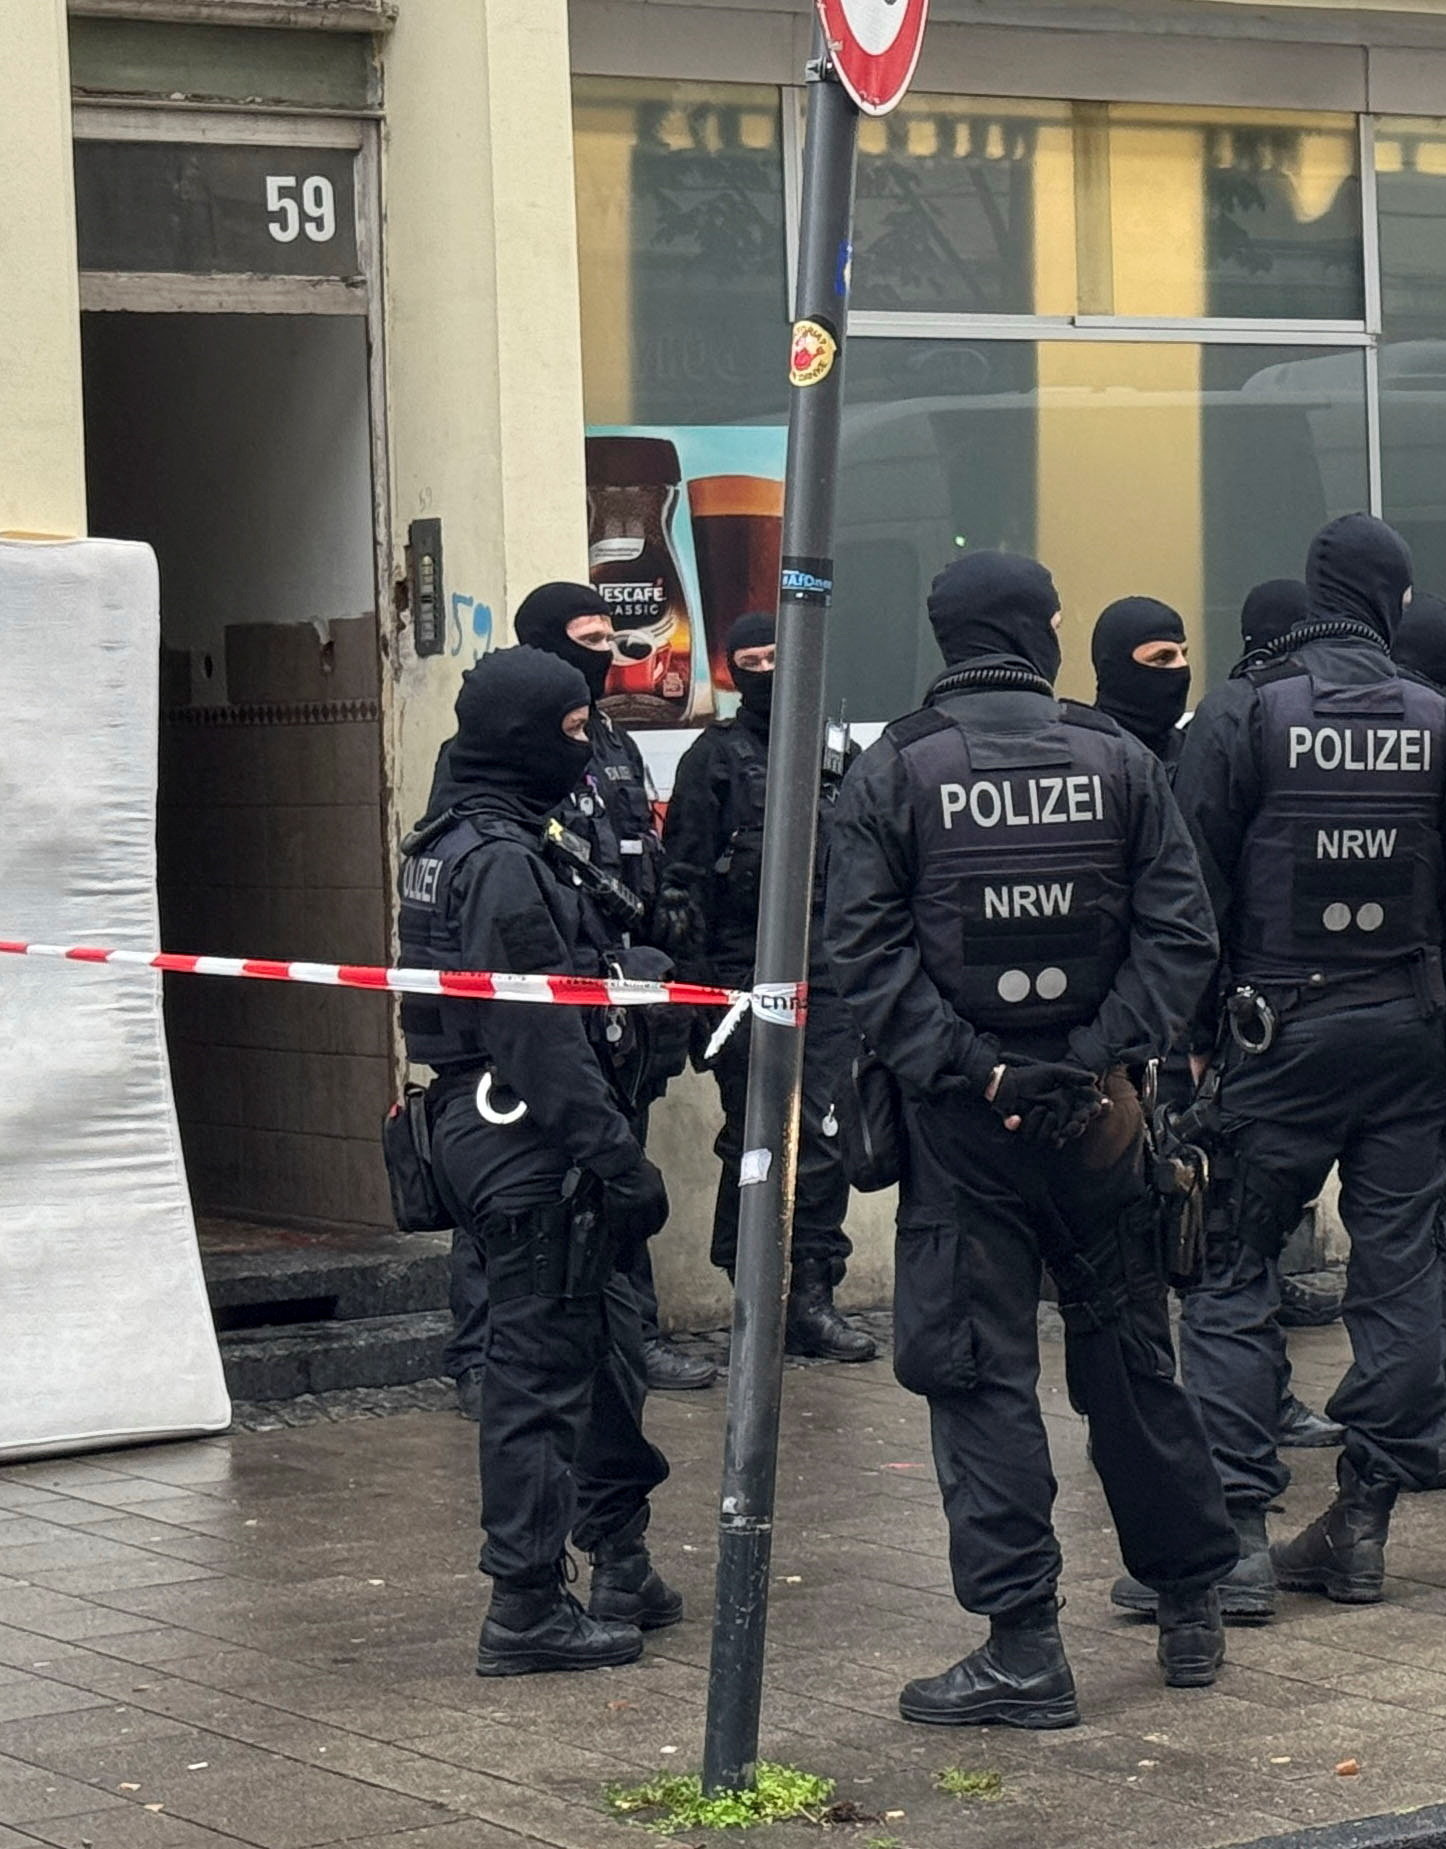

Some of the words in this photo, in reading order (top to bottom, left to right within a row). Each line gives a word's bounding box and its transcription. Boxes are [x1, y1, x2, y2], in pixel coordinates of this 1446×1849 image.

[266, 175, 335, 242] 59
[599, 577, 667, 602] ESCAFÉ
[610, 604, 659, 615] ASSIC
[1289, 727, 1431, 770] POLIZEI
[940, 774, 1104, 829] POLIZEI
[1316, 828, 1398, 859] NRW
[403, 856, 443, 904] OLIZEI
[984, 882, 1075, 919] NRW
